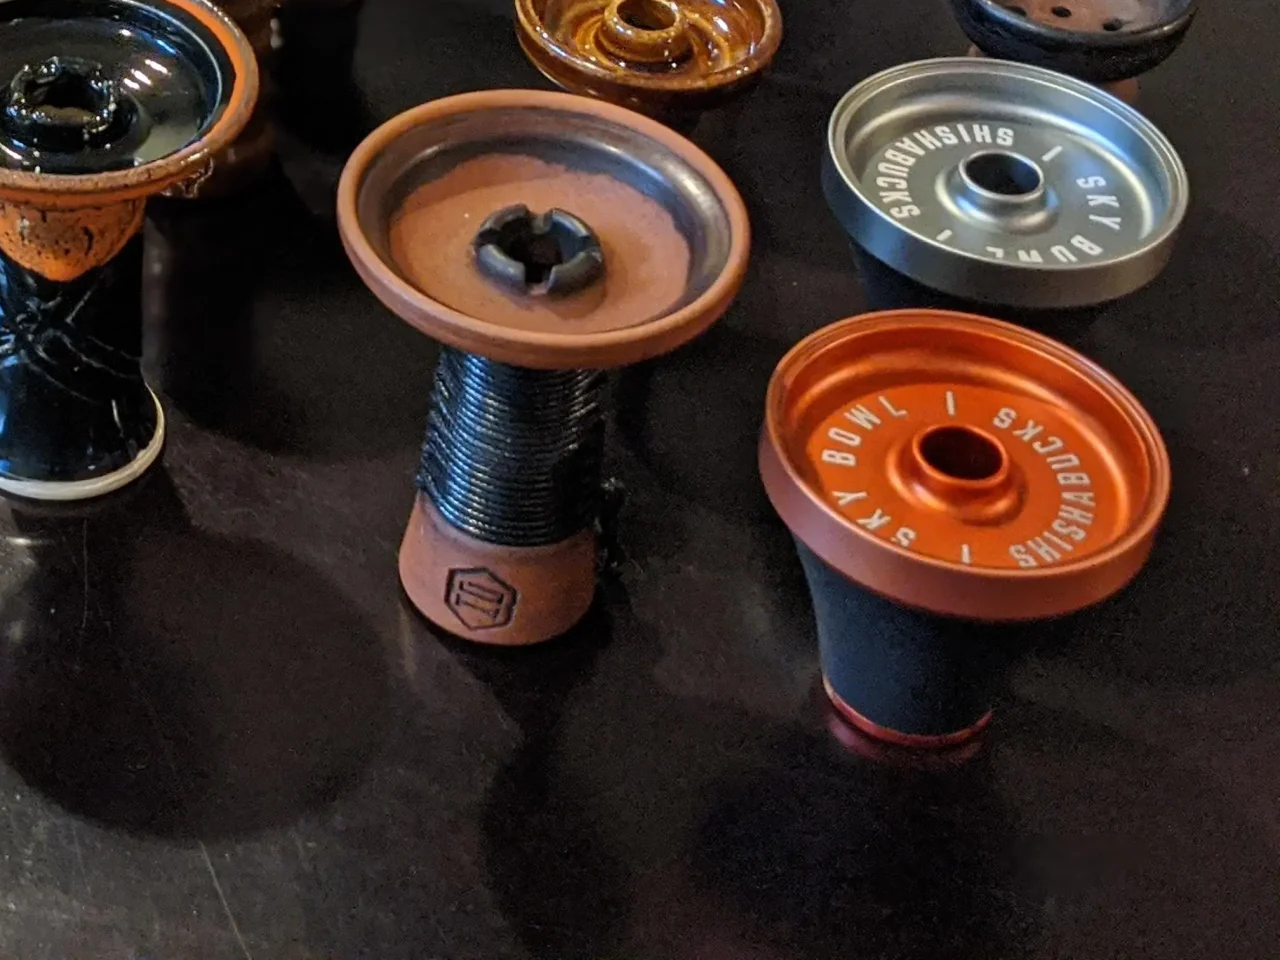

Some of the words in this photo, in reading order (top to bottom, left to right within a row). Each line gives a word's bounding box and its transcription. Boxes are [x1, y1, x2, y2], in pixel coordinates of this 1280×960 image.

[875, 123, 1015, 218] SHISHABUCKS
[1076, 176, 1122, 230] SKY
[821, 395, 908, 467] BOWL
[831, 490, 917, 547] SKY
[992, 407, 1096, 568] SHISHABUCKS
